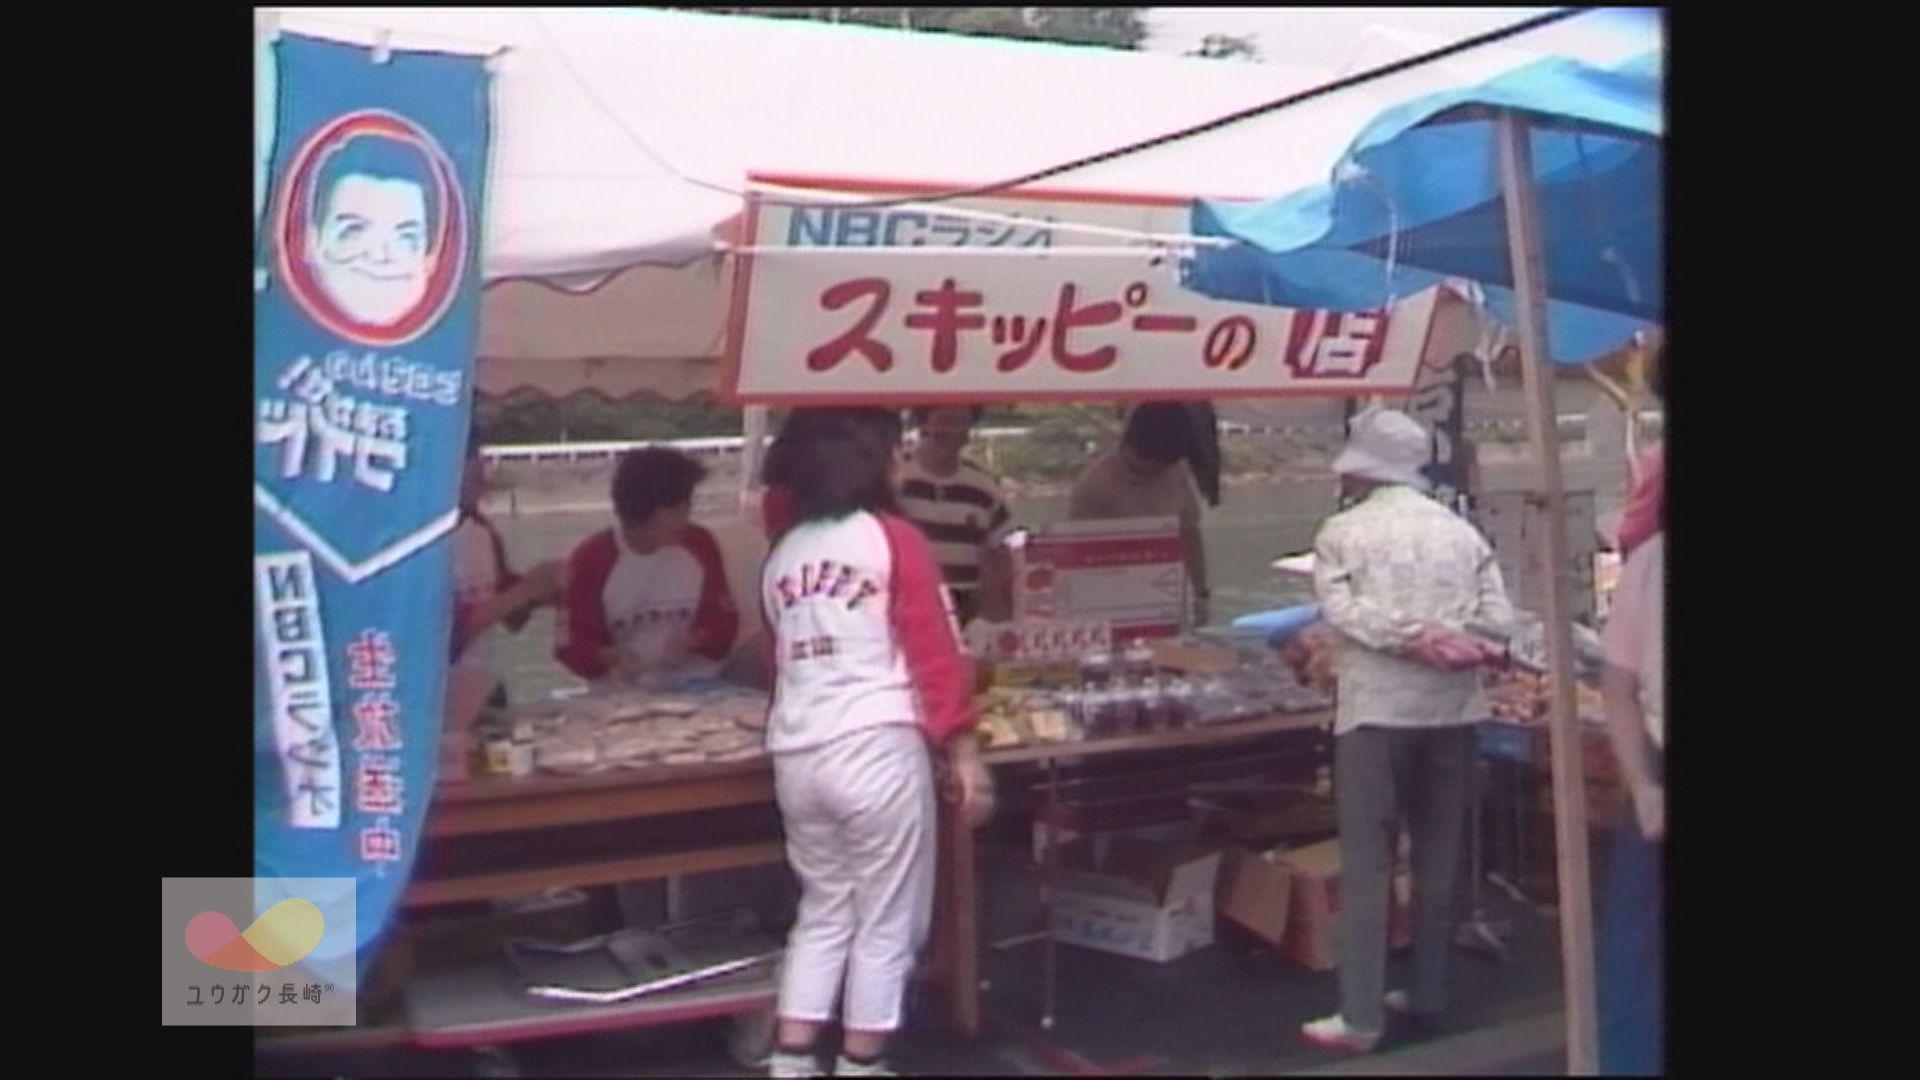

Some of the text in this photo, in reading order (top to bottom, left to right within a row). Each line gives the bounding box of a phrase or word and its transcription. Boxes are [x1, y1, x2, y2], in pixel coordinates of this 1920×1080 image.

[806, 276, 1392, 379] スキッピーの店
